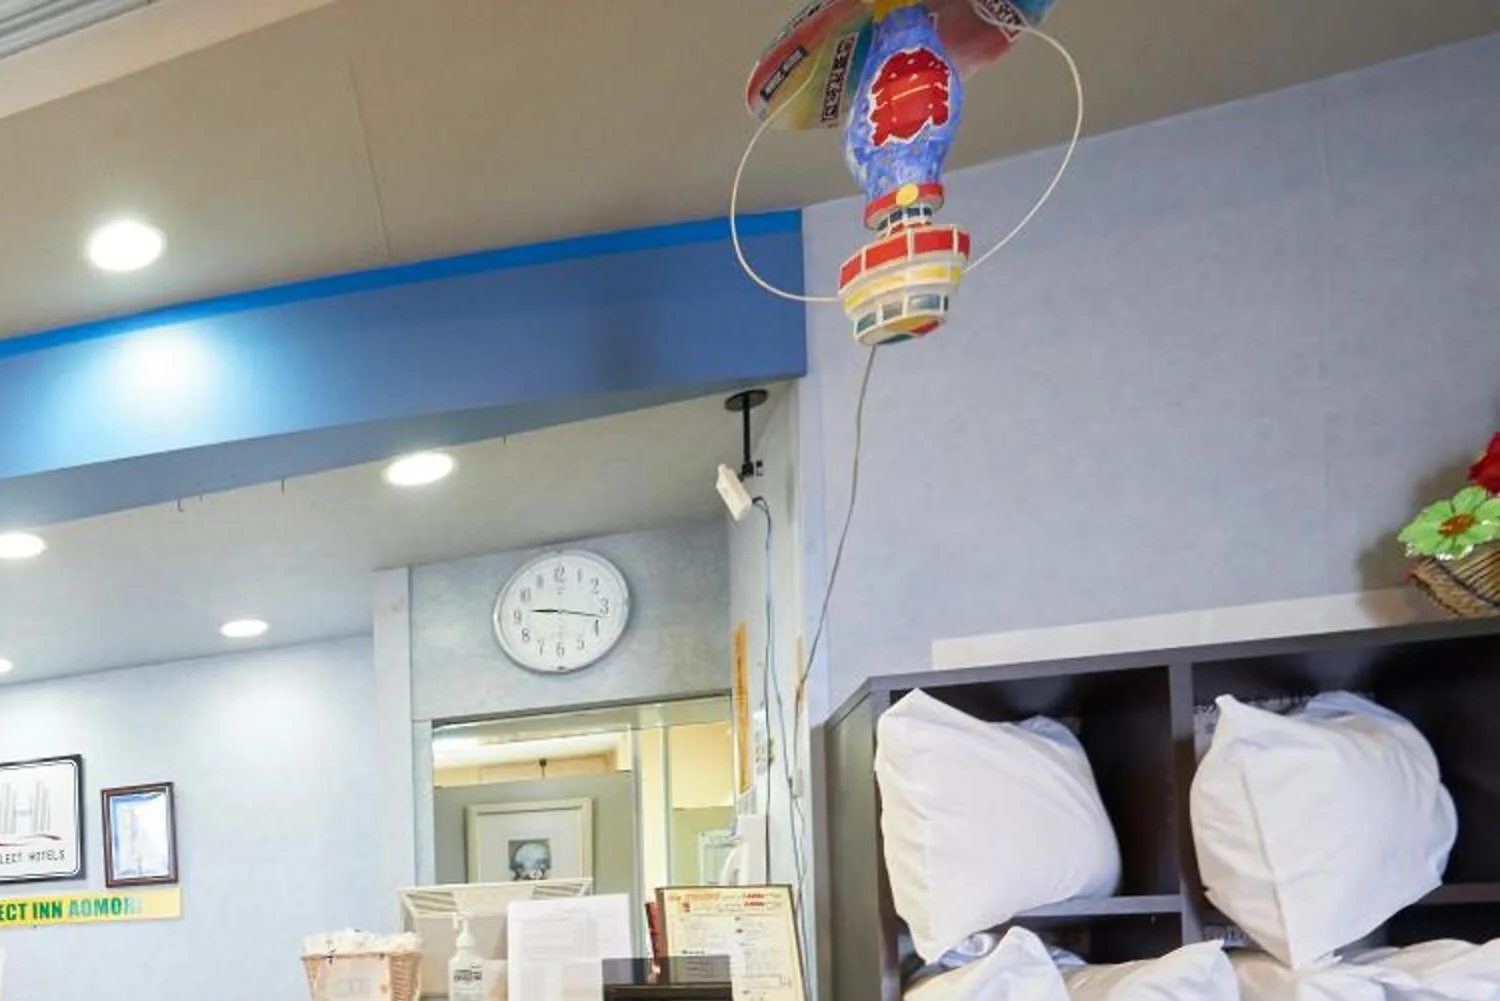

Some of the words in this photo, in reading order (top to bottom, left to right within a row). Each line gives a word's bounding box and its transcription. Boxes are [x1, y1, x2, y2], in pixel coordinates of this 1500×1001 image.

[554, 566, 566, 582] 12
[590, 577, 600, 594] 2
[520, 587, 531, 603] 10
[599, 598, 609, 615] 3
[513, 608, 522, 624] 9
[521, 628, 531, 641] 8
[556, 642, 565, 657] 6
[28, 848, 66, 862] HOTELS
[32, 901, 63, 920] INN
